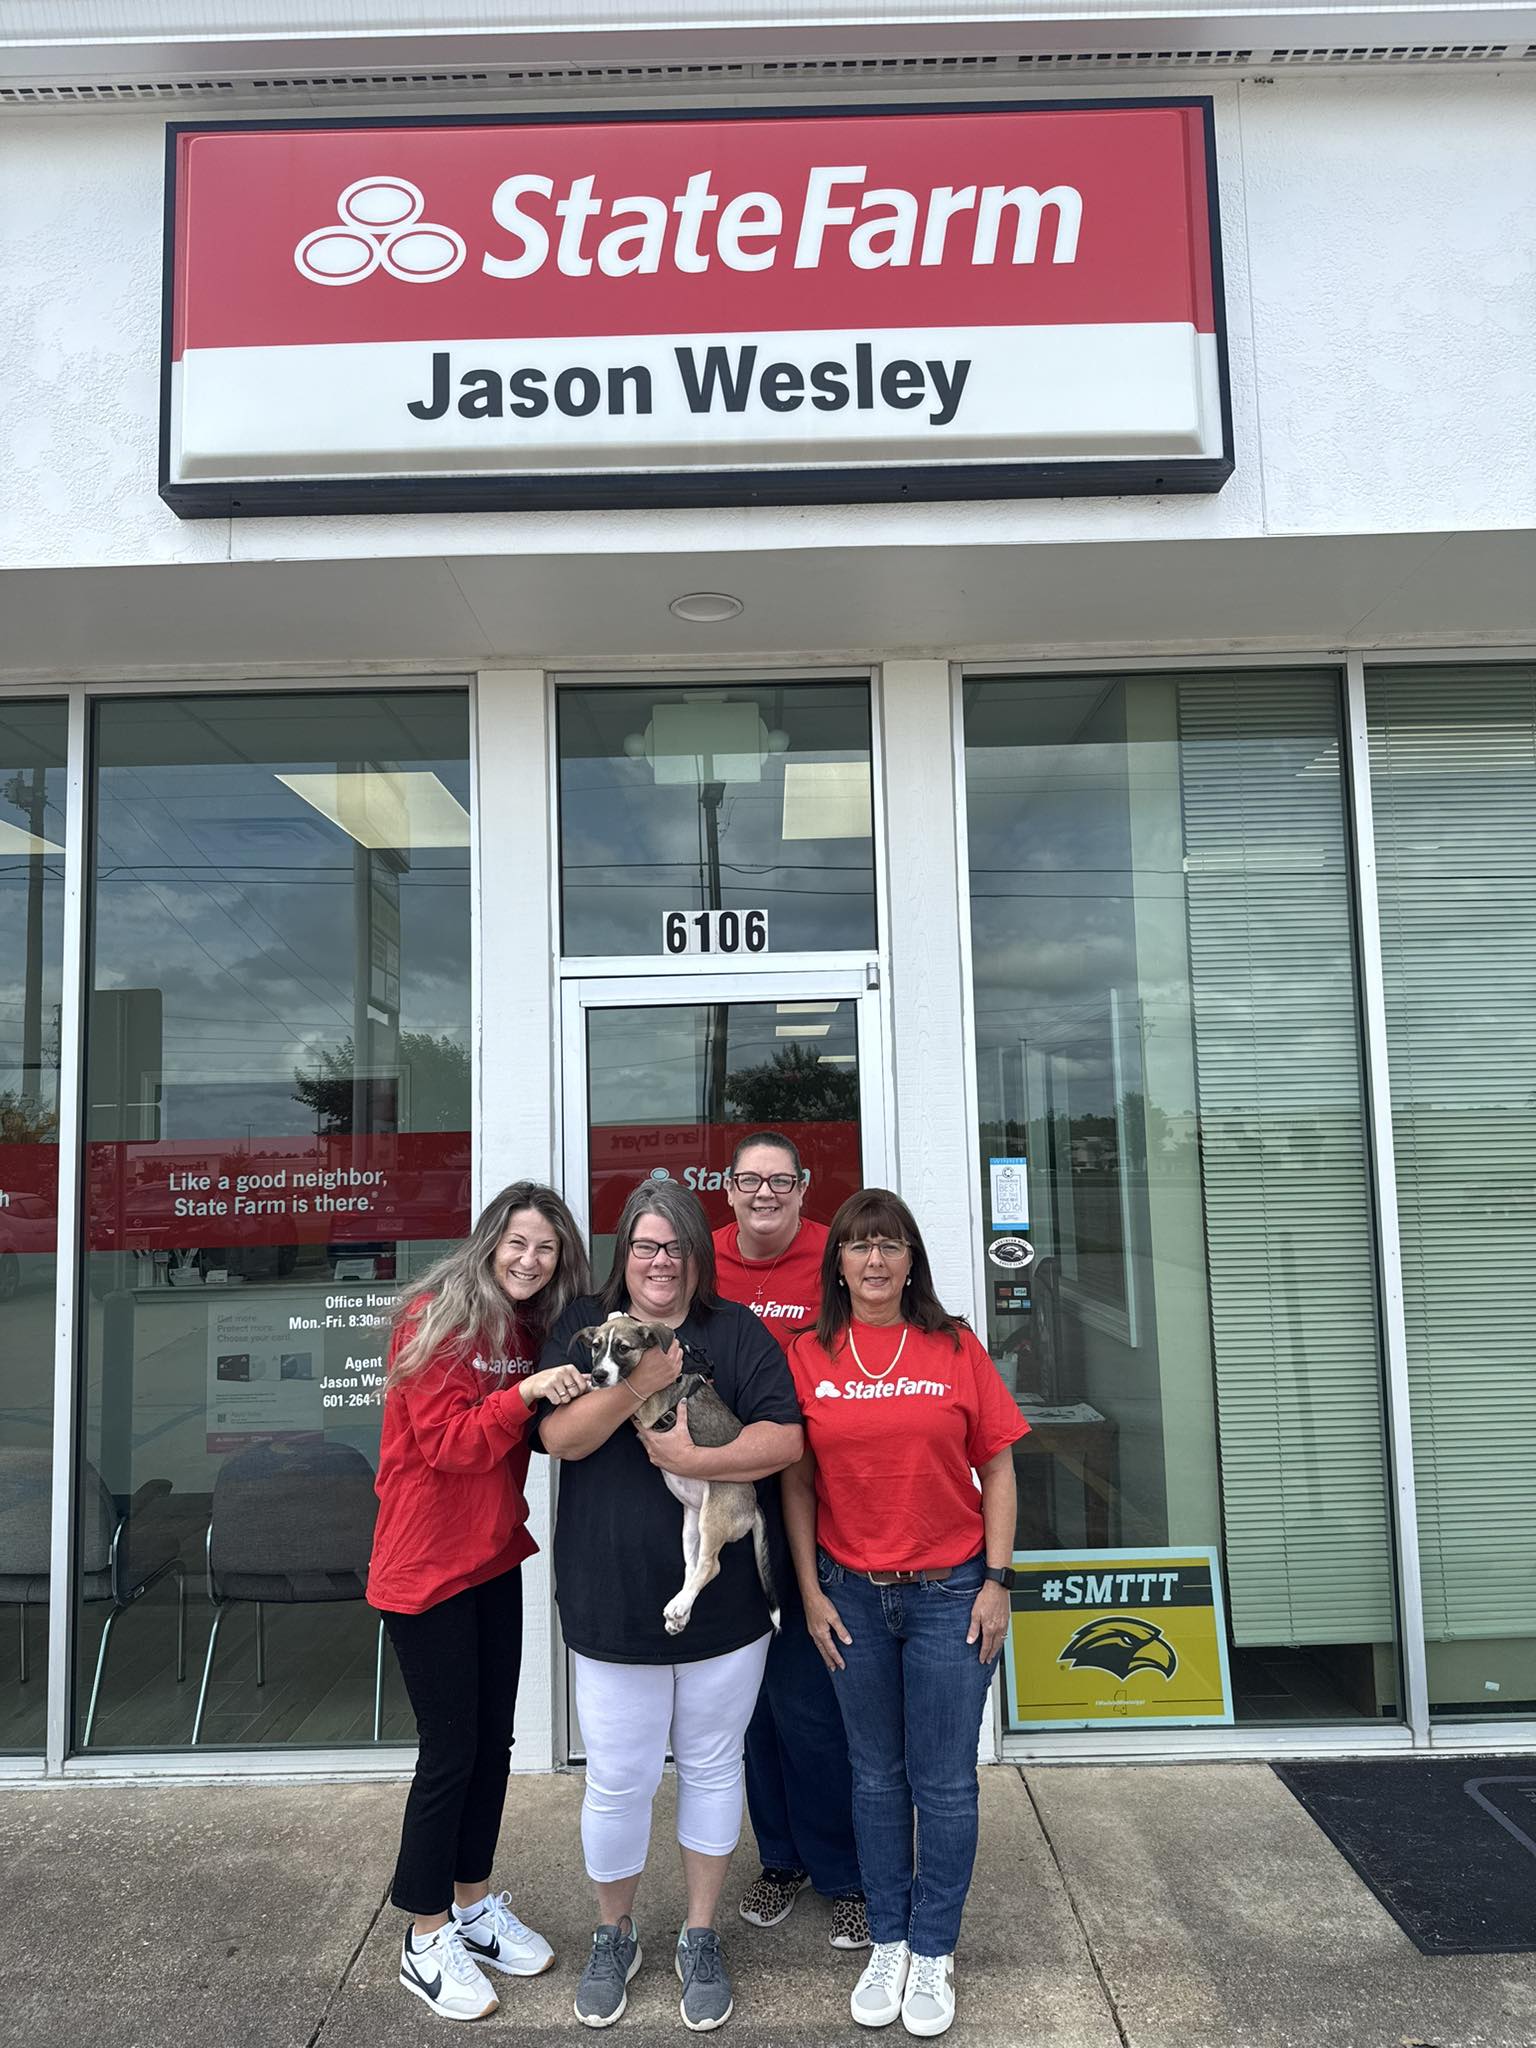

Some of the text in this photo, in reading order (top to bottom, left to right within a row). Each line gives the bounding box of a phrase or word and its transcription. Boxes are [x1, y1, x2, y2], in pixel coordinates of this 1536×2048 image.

[407, 343, 971, 425] Jason Wesley
[666, 910, 766, 954] 6106
[168, 1167, 388, 1193] Like a good neighbor,
[174, 1197, 228, 1217] State
[234, 1196, 286, 1216] Farm
[292, 1194, 308, 1213] is
[325, 1296, 363, 1309] Office
[289, 1315, 346, 1330] Mon.-Fri.
[344, 1356, 383, 1372] Agent
[320, 1376, 358, 1389] Jason
[1041, 1572, 1180, 1605] #SMTTT
